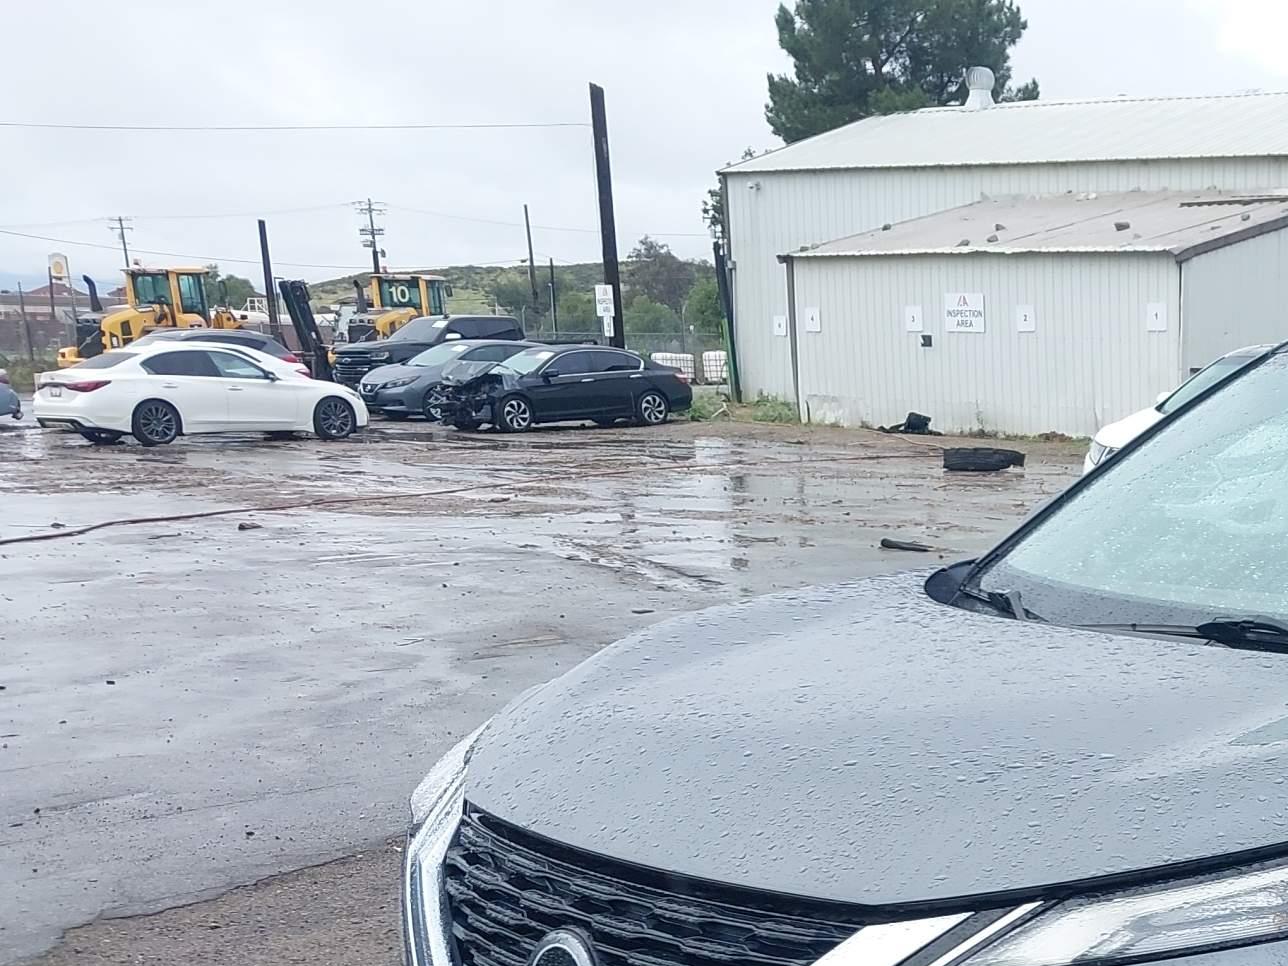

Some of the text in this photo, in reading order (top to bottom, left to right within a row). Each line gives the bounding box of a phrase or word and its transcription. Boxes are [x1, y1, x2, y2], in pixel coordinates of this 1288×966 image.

[389, 285, 410, 304] 10
[946, 309, 983, 318] INSPECTION
[956, 320, 974, 328] AREA
